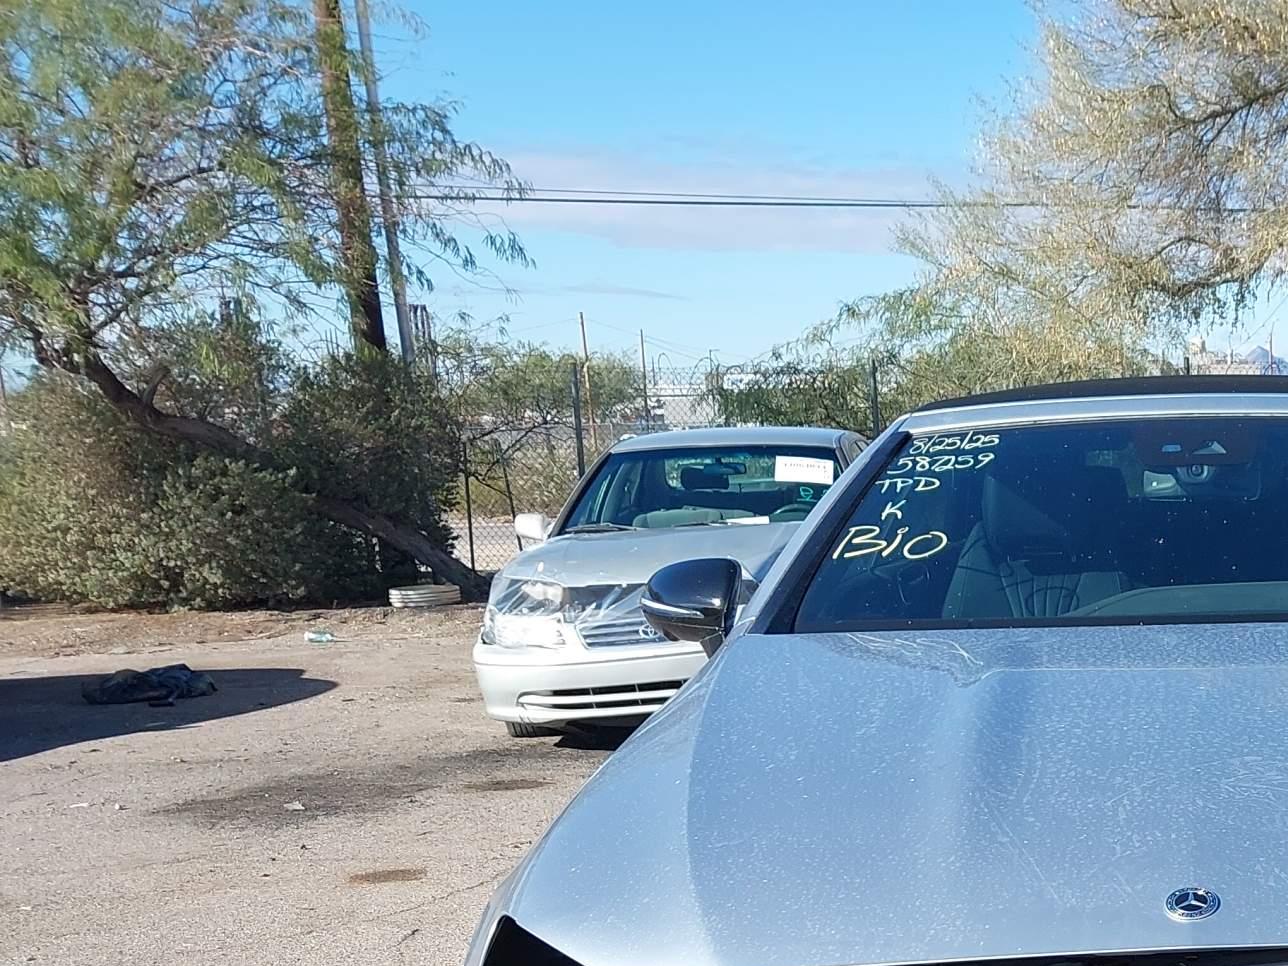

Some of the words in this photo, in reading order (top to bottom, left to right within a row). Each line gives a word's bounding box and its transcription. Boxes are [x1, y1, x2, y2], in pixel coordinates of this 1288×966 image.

[909, 430, 1000, 455] 8/25/25
[875, 476, 941, 494] TPD
[881, 499, 907, 520] K
